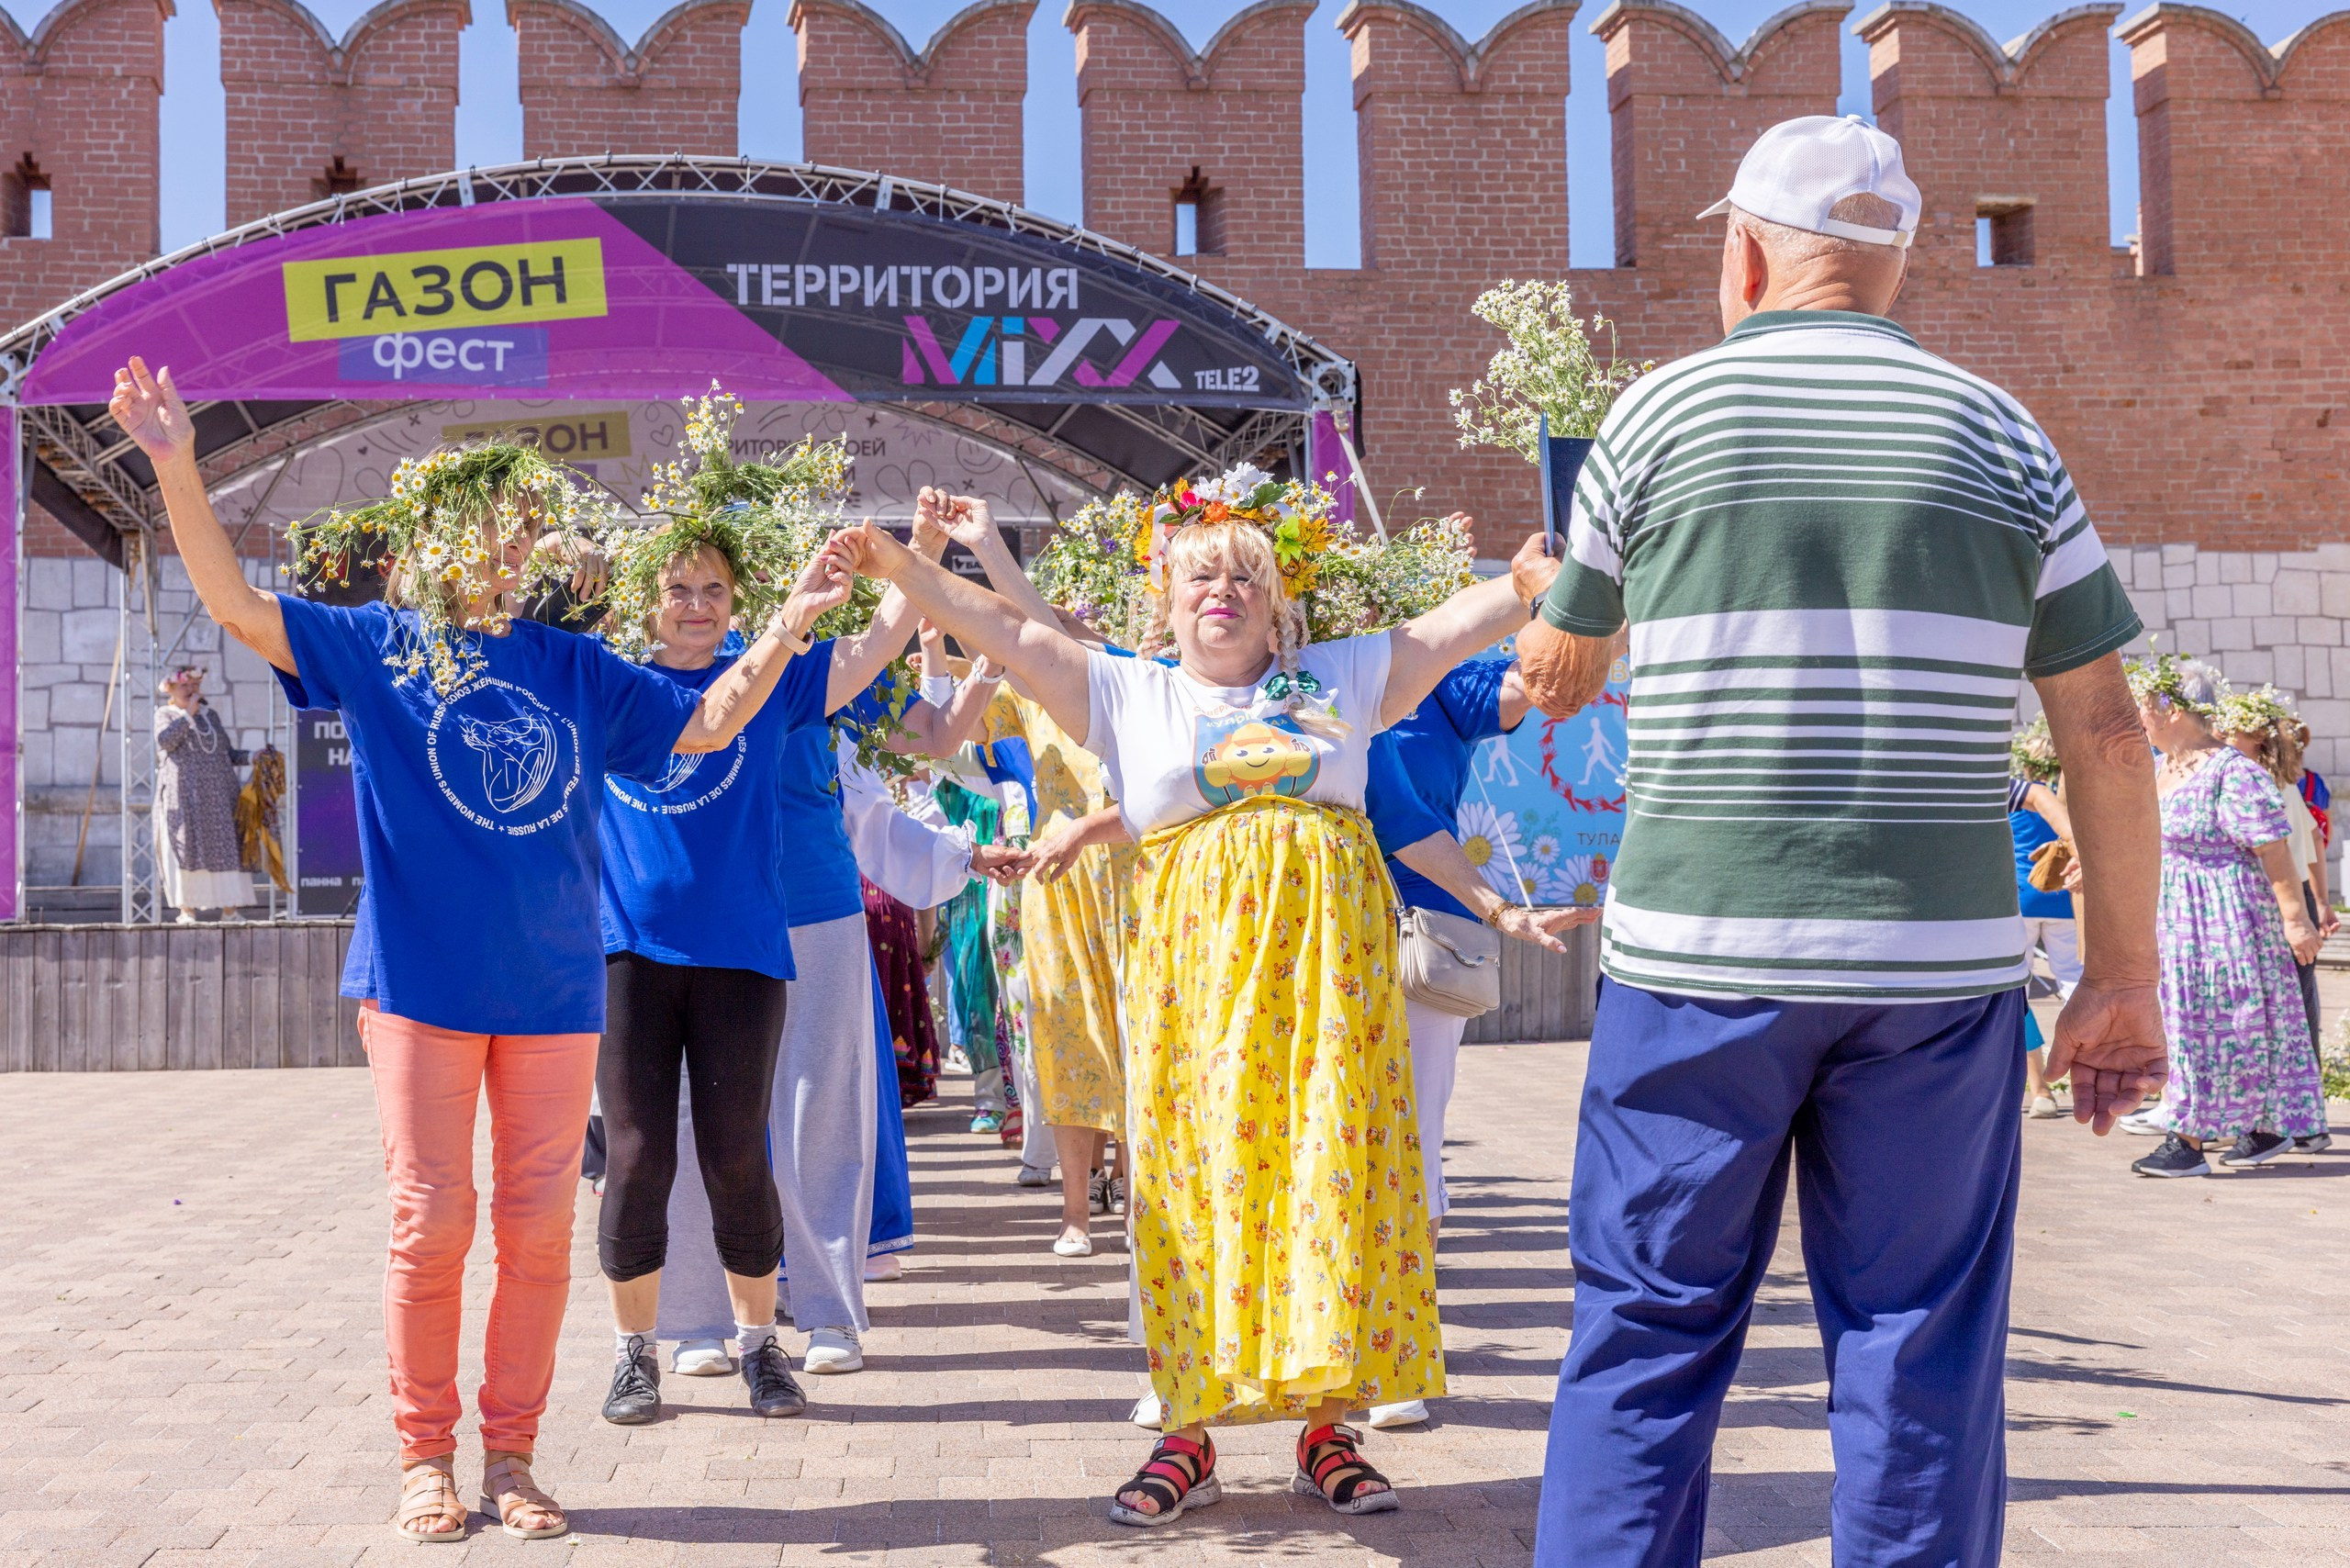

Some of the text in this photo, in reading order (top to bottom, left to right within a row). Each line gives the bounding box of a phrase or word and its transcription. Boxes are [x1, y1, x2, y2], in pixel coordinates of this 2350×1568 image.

[324, 256, 567, 323] ГАЗОН
[726, 263, 1079, 310] ТЕРРИТОРИЯ
[373, 331, 514, 379] фест
[1194, 365, 1260, 392] TELE2
[444, 677, 551, 711] СОЮЗ ЖЕНЩИН РОССИИ
[426, 731, 437, 745] OF
[560, 717, 579, 753] L'UNION
[737, 735, 746, 753] DES
[427, 747, 443, 780] UNION
[720, 753, 744, 790] FEMMES
[438, 779, 476, 821] WOMEN'S
[696, 794, 711, 806] LA
[708, 786, 722, 800] DE
[631, 798, 647, 812] THE
[661, 801, 698, 814] RUSSIE
[475, 815, 495, 830] THE
[536, 818, 550, 829] LA
[549, 809, 564, 823] DE
[507, 823, 537, 836] RUSSIE
[1576, 833, 1620, 846] ТУЛА
